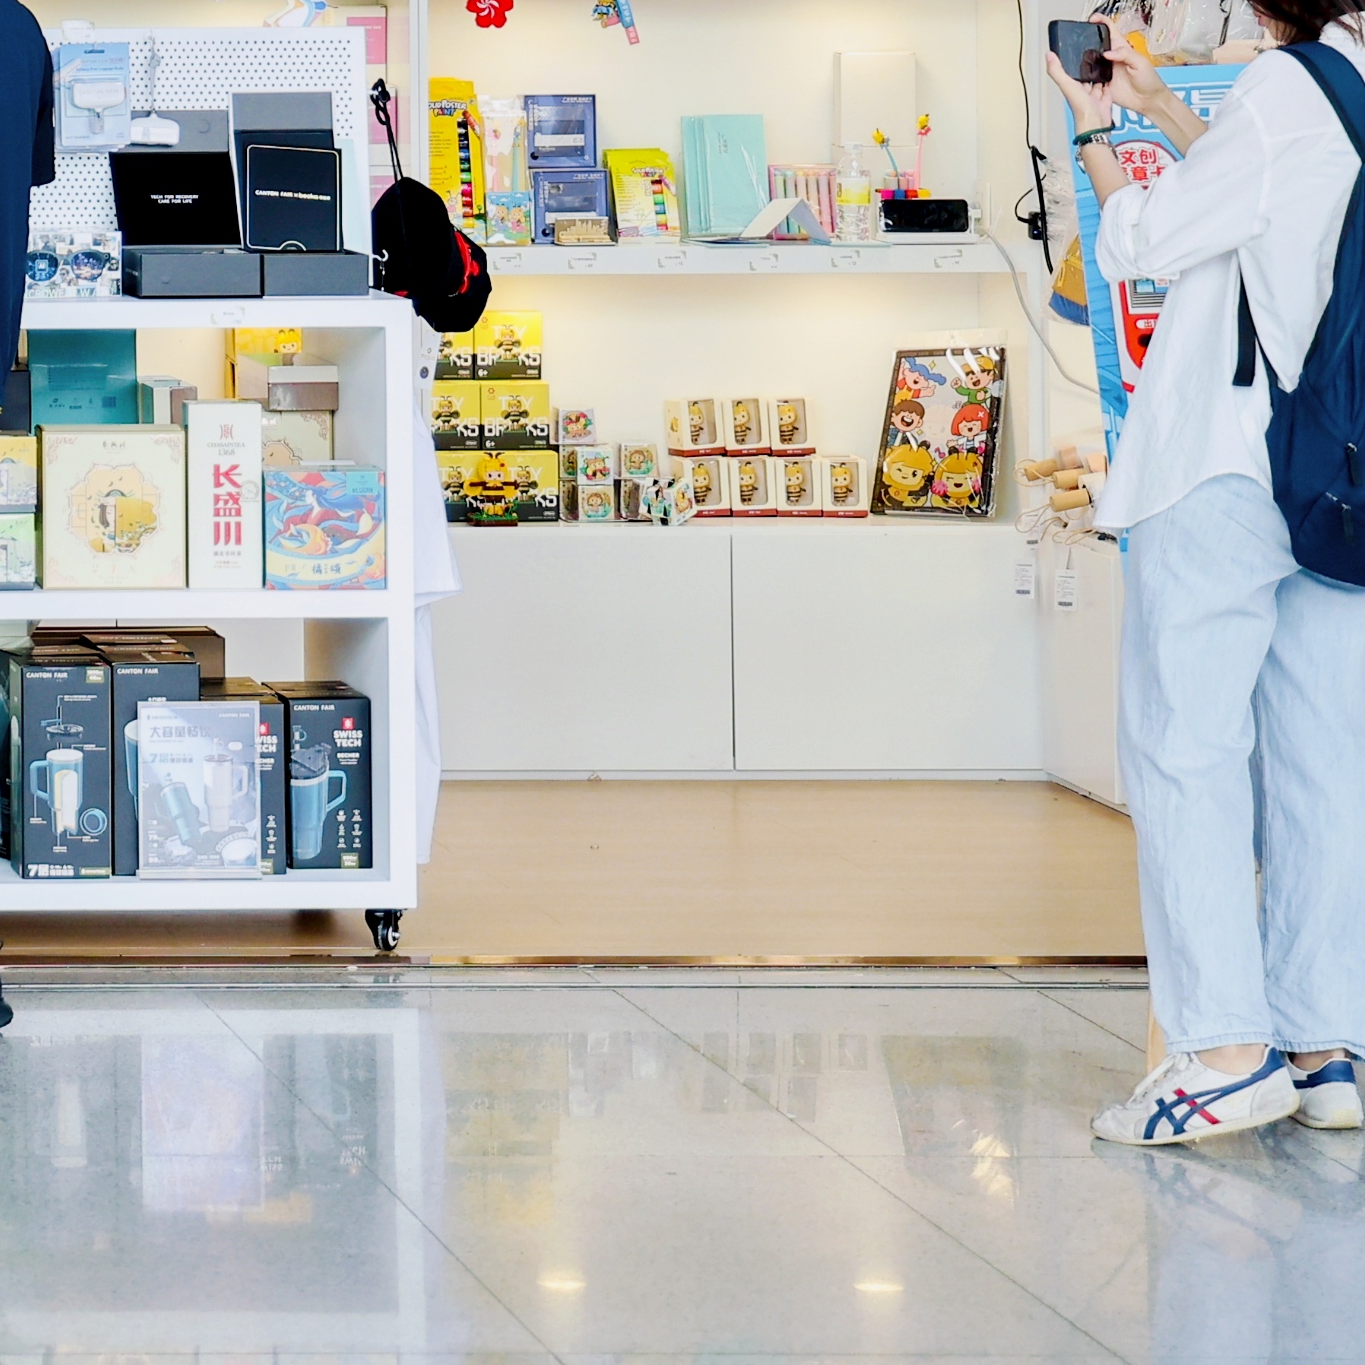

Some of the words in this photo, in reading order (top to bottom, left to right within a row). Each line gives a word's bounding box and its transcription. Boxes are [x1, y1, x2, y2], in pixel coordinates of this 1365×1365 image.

[1119, 148, 1157, 165] 文创
[254, 189, 279, 197] CANTON
[477, 368, 489, 378] 6+
[485, 439, 496, 449] 6+
[212, 463, 242, 546] 长盛川
[293, 704, 319, 712] CANTON
[254, 735, 278, 744] WISS
[333, 730, 364, 740] SWISS
[335, 738, 362, 748] TECH
